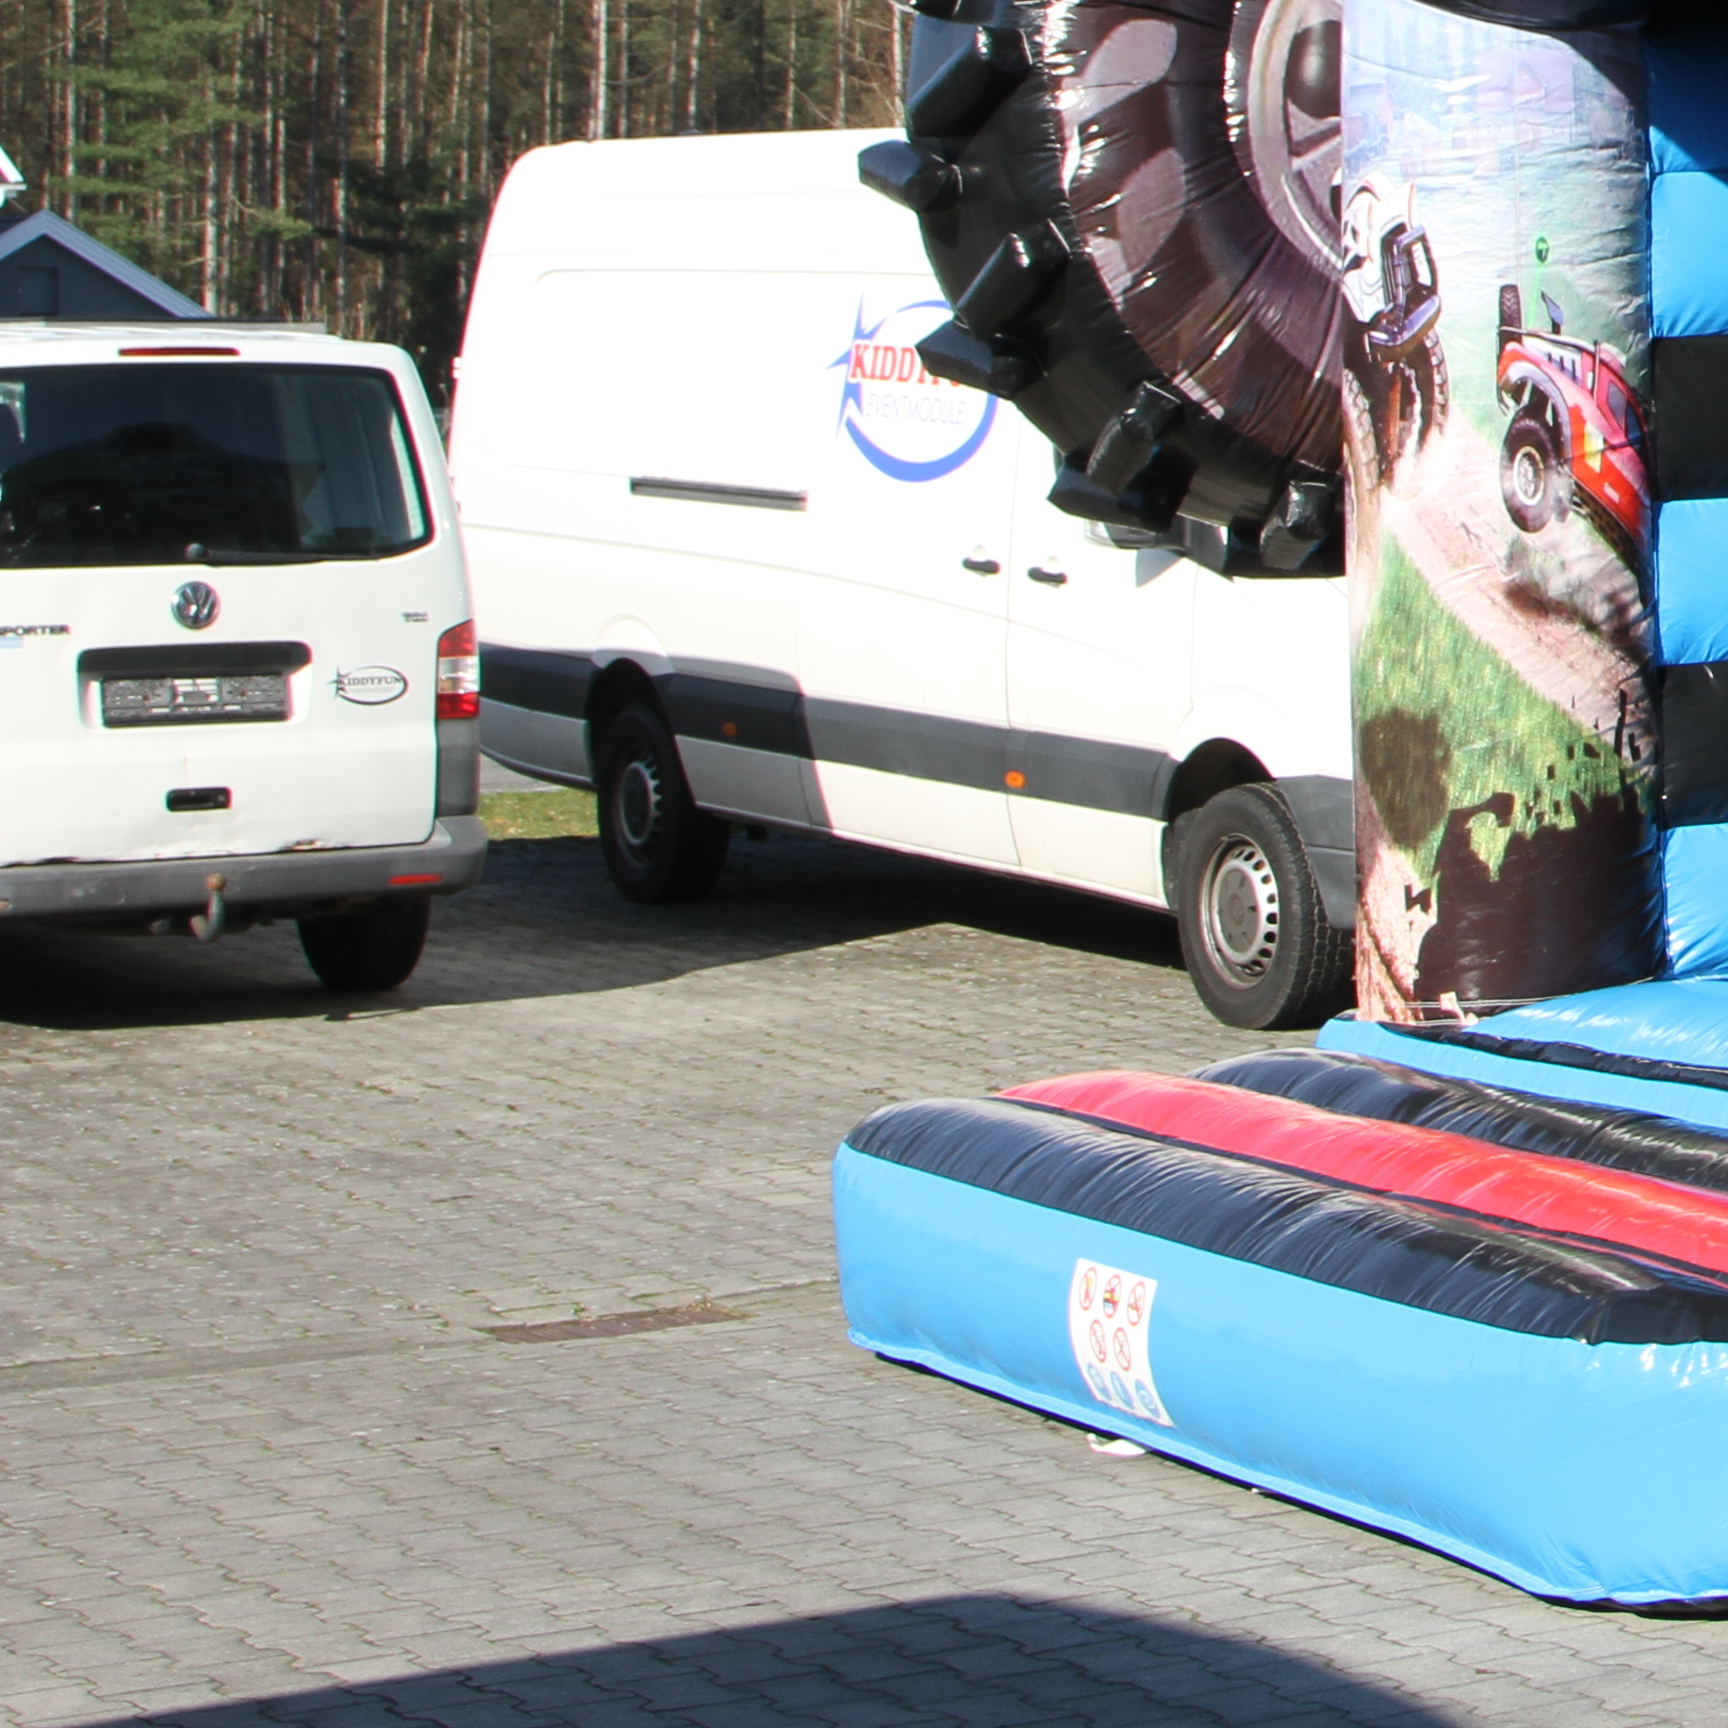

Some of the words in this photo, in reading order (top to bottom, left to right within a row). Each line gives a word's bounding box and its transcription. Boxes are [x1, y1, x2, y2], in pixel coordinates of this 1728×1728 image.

[850, 343, 960, 387] KIDD
[865, 392, 967, 425] EVENTMODULE
[0, 624, 71, 637] PORTER
